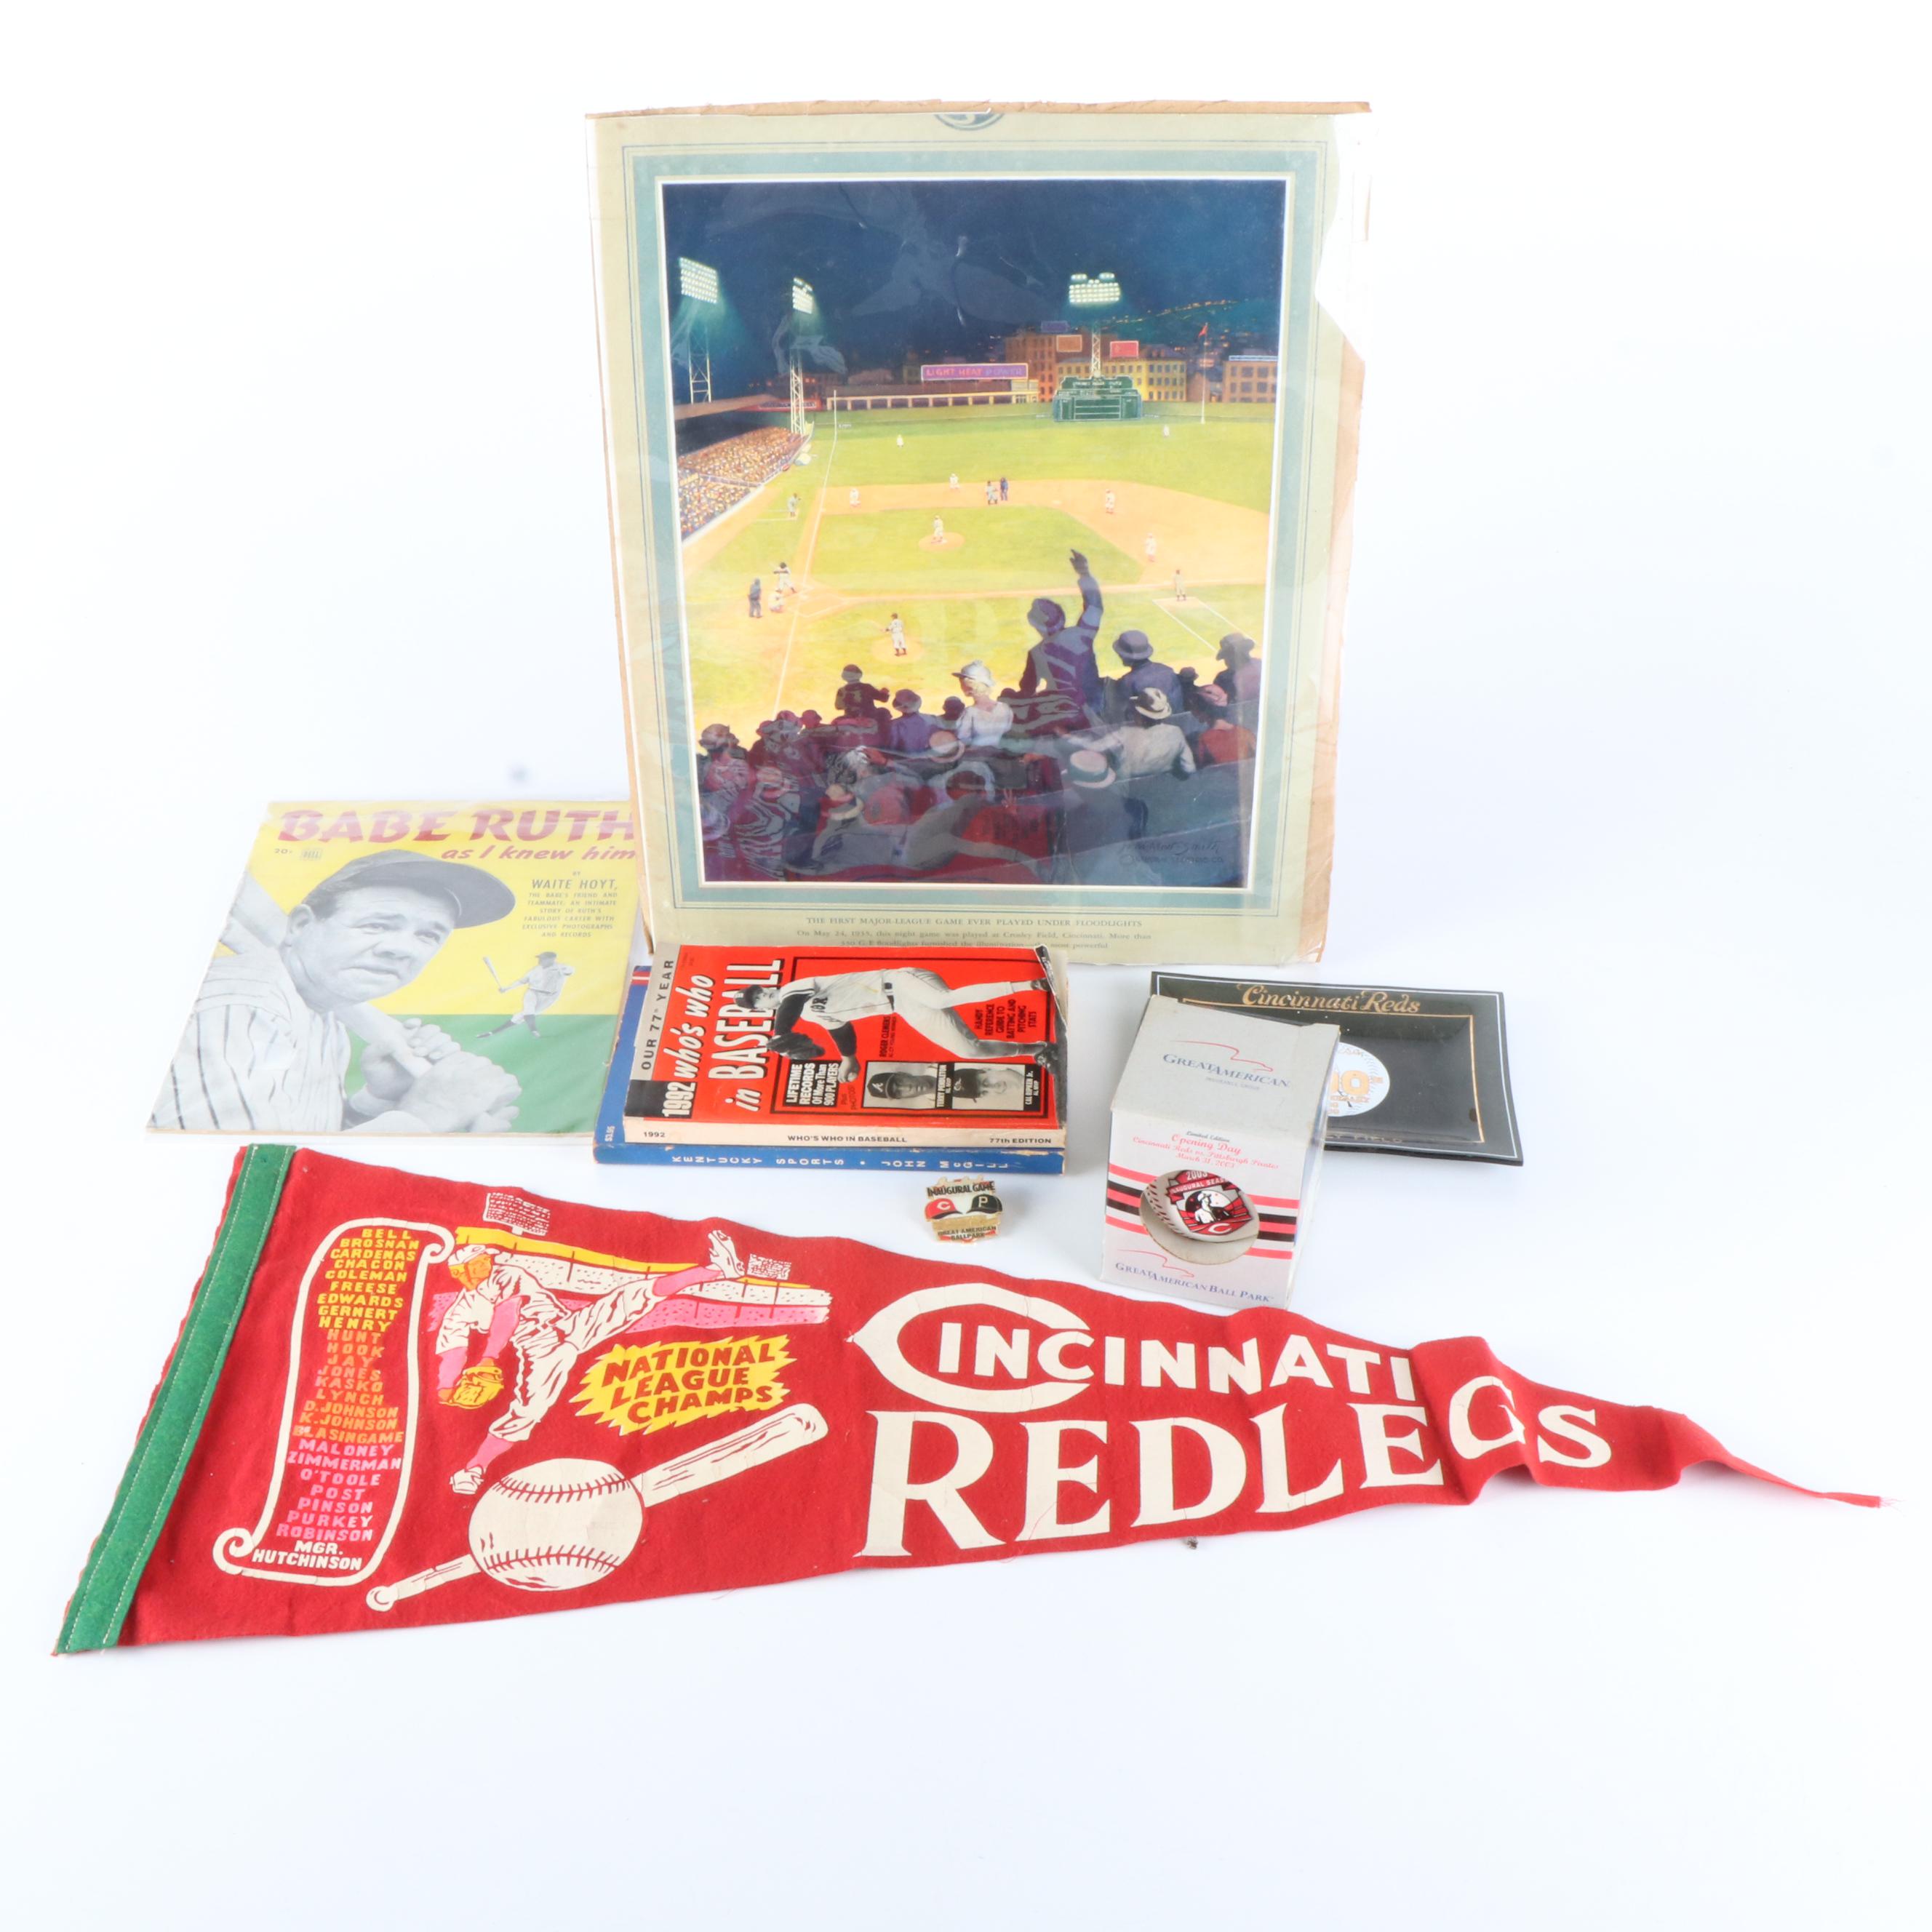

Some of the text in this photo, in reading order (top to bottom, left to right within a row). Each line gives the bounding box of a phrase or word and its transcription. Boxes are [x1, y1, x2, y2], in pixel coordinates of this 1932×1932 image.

[959, 368, 981, 376] HEAT
[277, 809, 635, 843] BABE RUTH
[442, 845, 635, 860] as I knew him
[532, 879, 618, 890] WAITE HOYT,
[962, 931, 988, 939] played
[1238, 983, 1421, 1013] Cincinnati Reds
[642, 959, 674, 1069] OUR YEAR
[985, 1004, 994, 1035] REFERENCE
[996, 1006, 1005, 1033] GUIDE TO
[1007, 999, 1016, 1039] BATTING AND
[1018, 1005, 1026, 1032] PITCHING
[1029, 1011, 1037, 1027] STATS
[708, 959, 781, 1111] in BASEBLL
[662, 975, 714, 1117] 1992 who's who
[786, 1064, 803, 1103] LIFETIME
[799, 1063, 815, 1104] RECORDS
[823, 1063, 839, 1106] 900 PLAYERS
[787, 1135, 820, 1143] WHO'S
[858, 1135, 907, 1143] BASEBALL
[1133, 1136, 1170, 1149] Cincinnati
[1171, 1134, 1242, 1154] Opening Day
[672, 1156, 762, 1164] KENTUCKY
[881, 1160, 926, 1168] JOHN
[939, 1160, 1008, 1169] McGILL
[1175, 1152, 1199, 1162] March
[1187, 1170, 1208, 1181] 2003
[926, 1181, 995, 1197] INAUGURAL GAME
[937, 1201, 951, 1210] C
[978, 1196, 988, 1208] P
[362, 1228, 412, 1240] BELL
[961, 1226, 996, 1234] AMERICAN
[1208, 1223, 1232, 1234] C
[340, 1238, 419, 1250] BROSNAN
[330, 1248, 416, 1261] CARDENAS
[334, 1258, 405, 1270] CHACON
[324, 1269, 407, 1282] COLEMAN
[330, 1281, 397, 1294] FREESE
[1209, 1285, 1236, 1297] BALL
[317, 1293, 404, 1308] EDWARDS
[318, 1305, 398, 1321] GERNERT
[318, 1317, 392, 1332] HENRY
[327, 1328, 382, 1344] HUNT
[327, 1343, 385, 1358] HOOK
[847, 1282, 1419, 1413] CINCINNATI
[328, 1354, 375, 1368] JAY
[602, 1343, 775, 1387] NATIONAL
[317, 1365, 381, 1381] JONES
[315, 1376, 383, 1392] KASKO
[610, 1366, 750, 1410] LEAGUE
[316, 1388, 384, 1405] LYNCH
[627, 1384, 775, 1424] CHAMPS
[292, 1425, 404, 1444] BLASINGAME
[298, 1439, 395, 1457] MALONEY
[287, 1451, 402, 1471] ZIMMERMAN
[853, 1375, 1613, 1558] REDLEGS
[300, 1469, 381, 1486] O'TOOLE
[310, 1485, 366, 1501] POST
[297, 1497, 373, 1514] PINSON
[287, 1510, 373, 1528] PURKEY
[276, 1523, 373, 1541] ROBINSON
[294, 1540, 343, 1555] MGR.
[252, 1549, 362, 1570] HUTCHINSON
